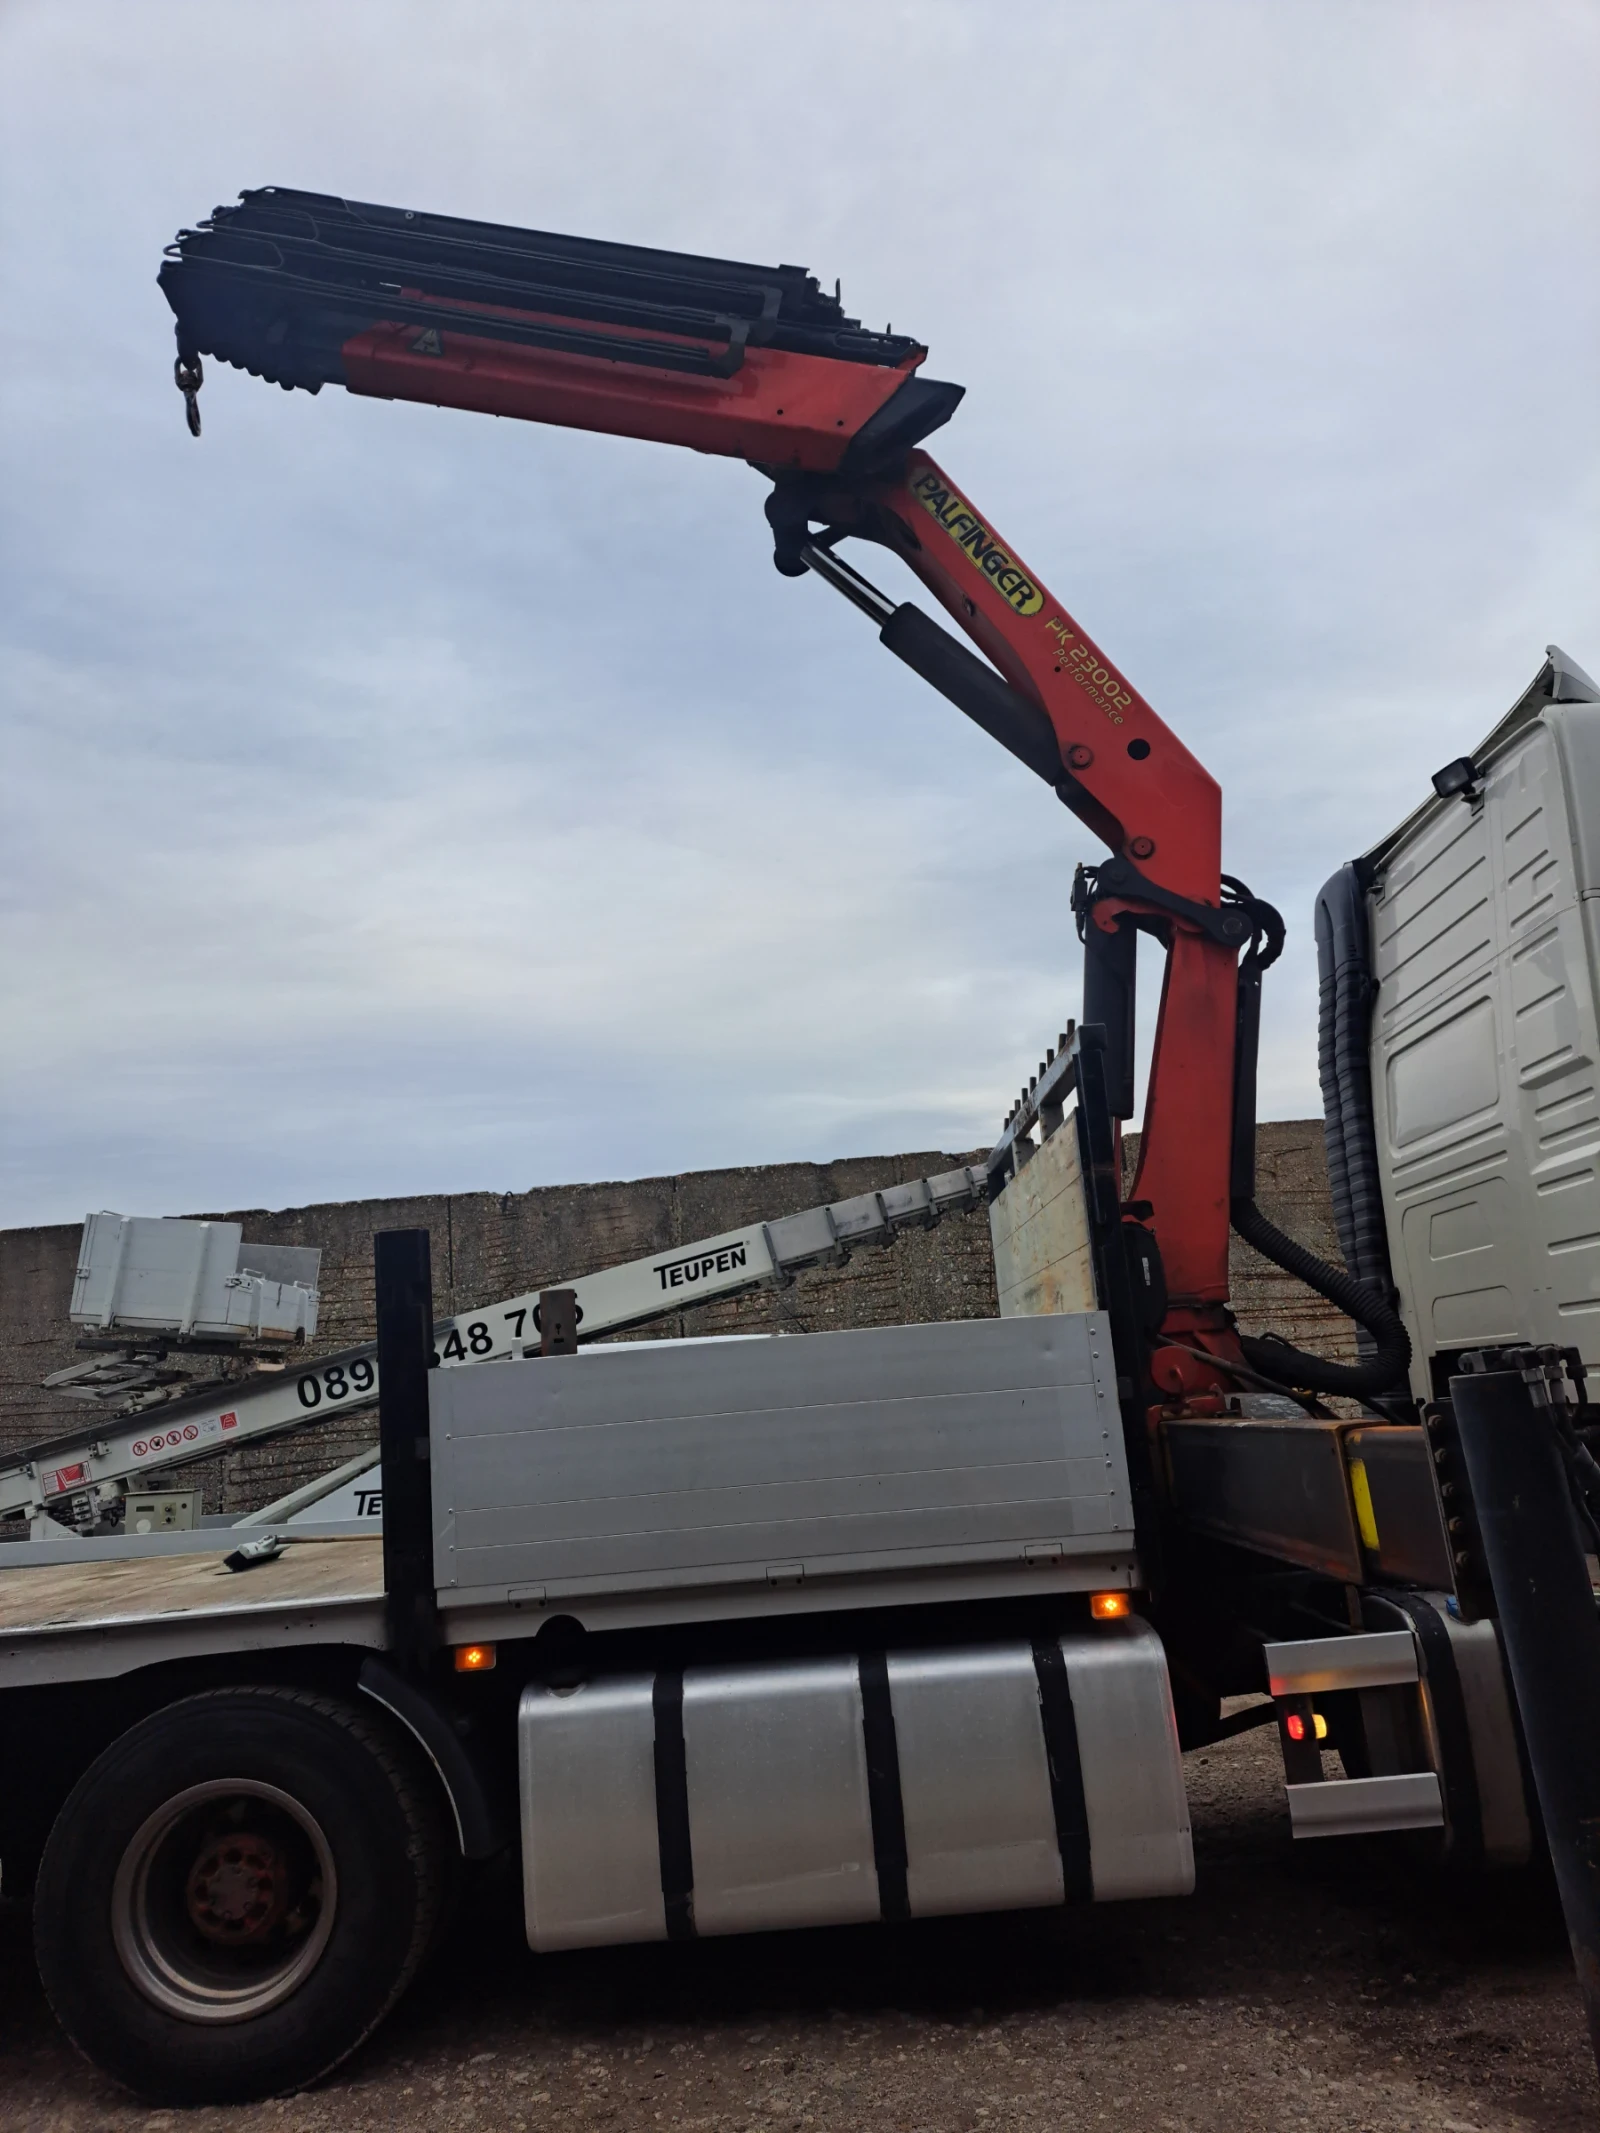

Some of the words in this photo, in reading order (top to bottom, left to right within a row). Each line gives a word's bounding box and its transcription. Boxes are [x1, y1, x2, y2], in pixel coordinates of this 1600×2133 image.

[913, 473, 1036, 608] PALFINGER
[1045, 616, 1075, 646] PK
[1069, 643, 1132, 710] 23002
[1052, 648, 1124, 724] Performance
[653, 1241, 746, 1290] TEUPEN
[297, 1358, 379, 1408] 089
